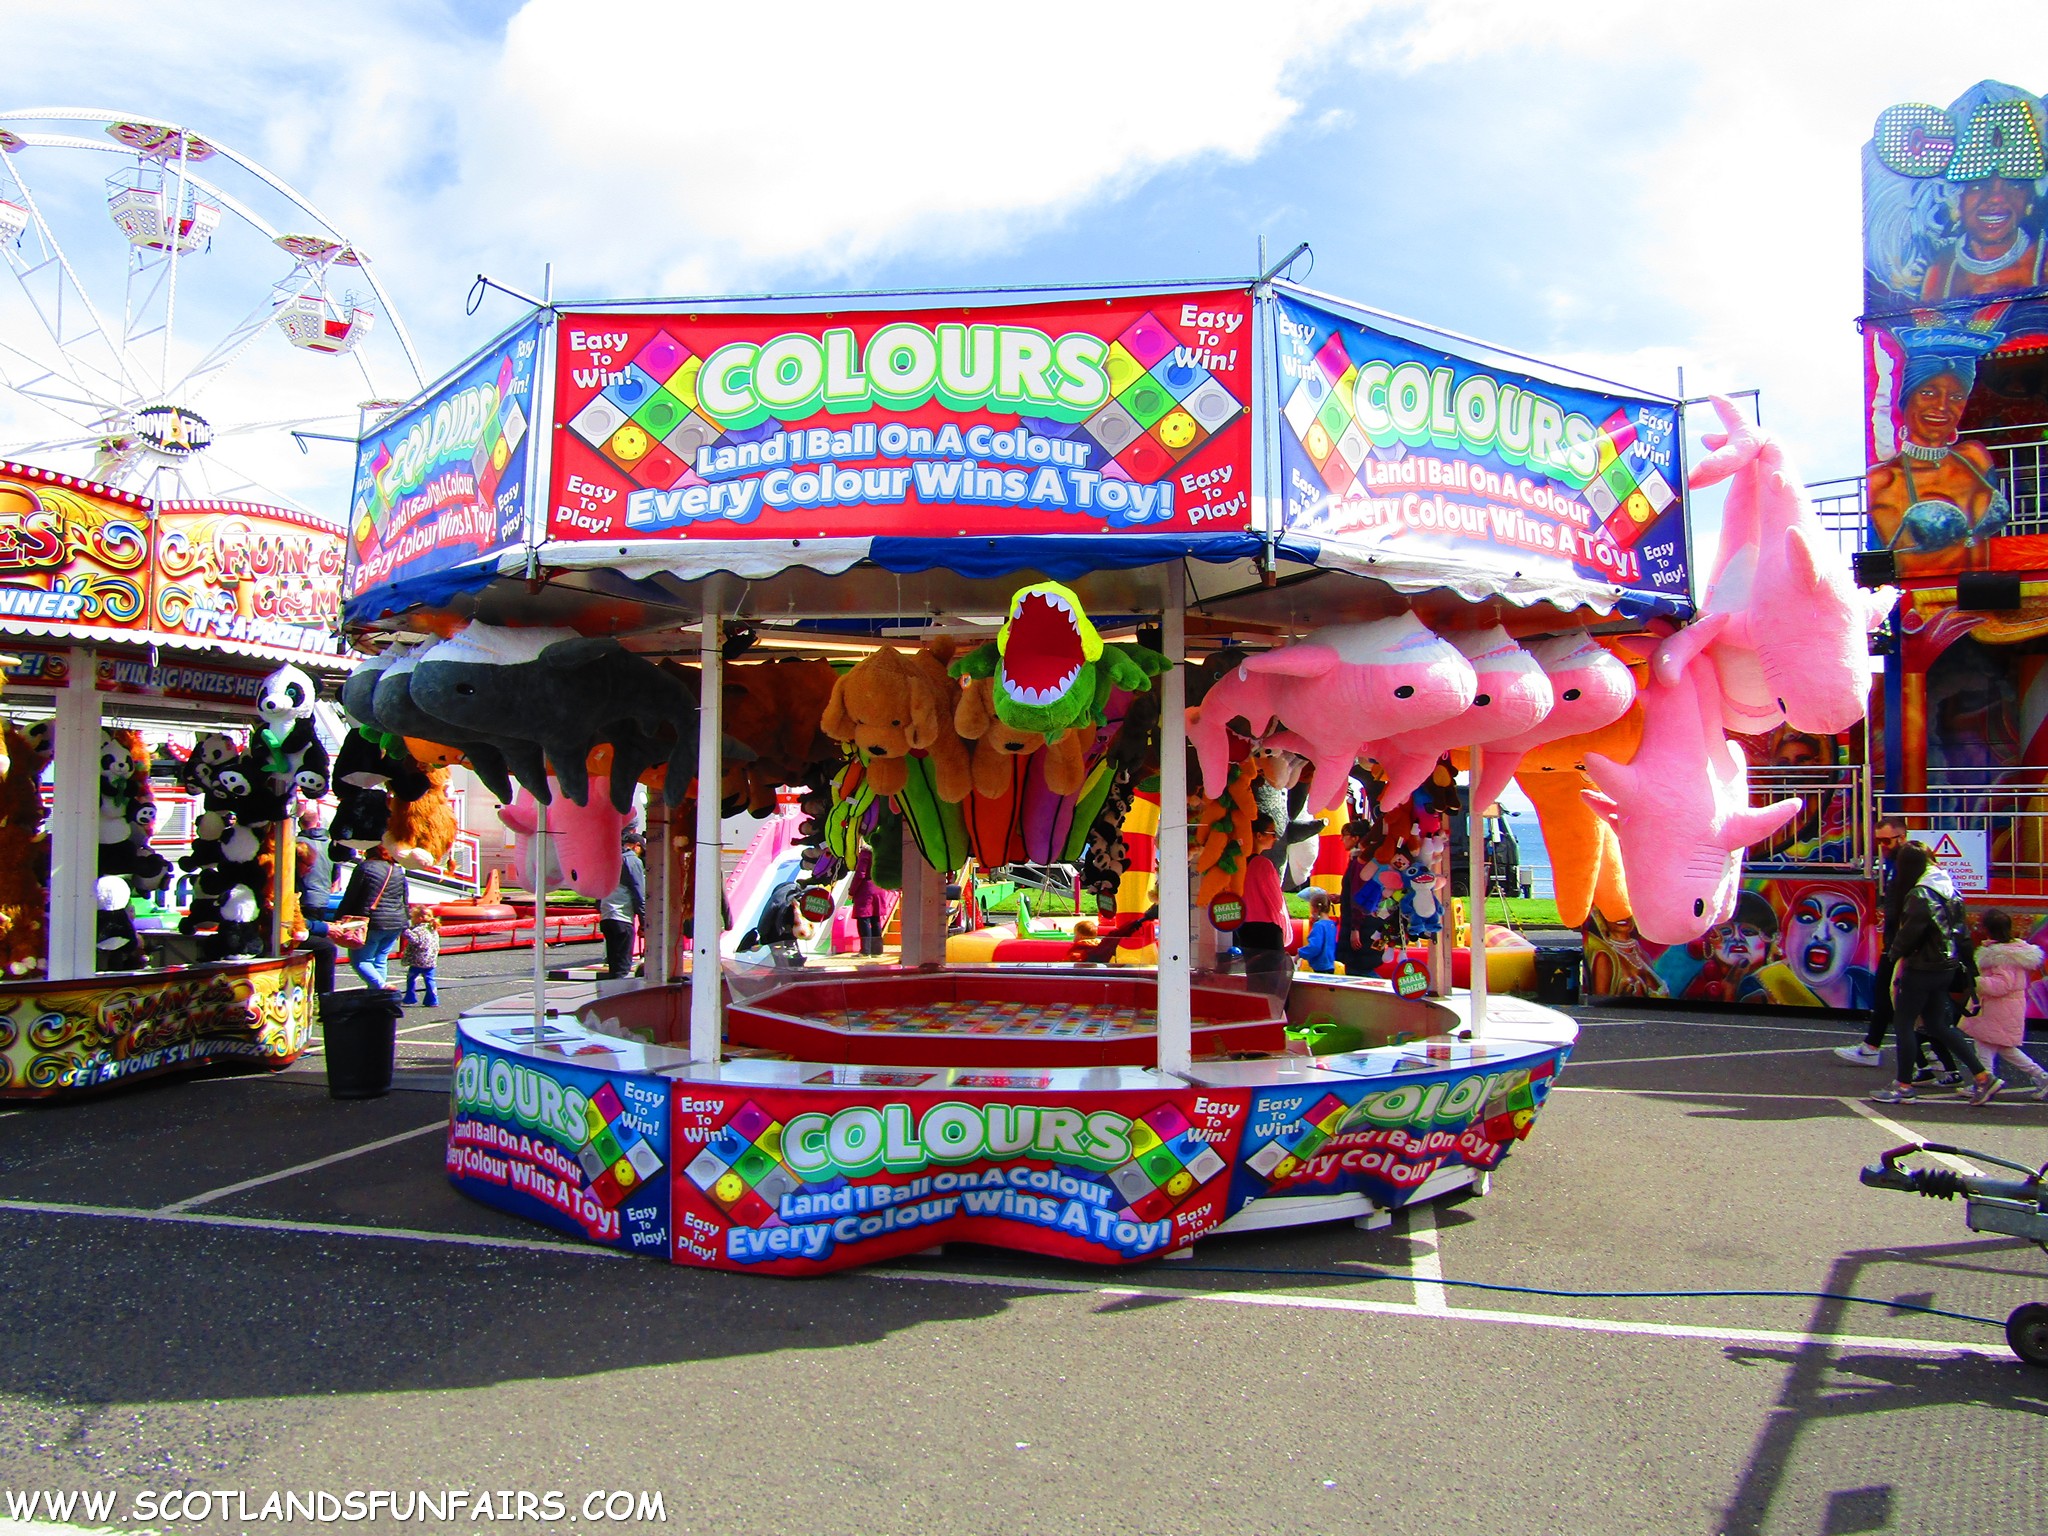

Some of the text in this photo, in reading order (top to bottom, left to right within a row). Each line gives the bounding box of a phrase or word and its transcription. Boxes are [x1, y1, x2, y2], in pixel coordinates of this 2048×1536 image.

[1180, 305, 1243, 333] Easy
[1280, 313, 1315, 344] Easy
[571, 331, 628, 354] Easy
[1197, 331, 1220, 347] To
[1291, 338, 1304, 356] To
[590, 352, 612, 366] To
[697, 323, 1110, 416] COLOURS
[1174, 346, 1237, 371] Win!
[1282, 354, 1317, 382] Win!
[573, 365, 632, 388] Win!
[1353, 361, 1600, 481] COLOURS
[1638, 407, 1674, 437] Easy
[384, 382, 497, 500] COLOURS
[1646, 429, 1661, 444] To
[698, 423, 1091, 478] Land 1 Ball On A Colour
[1633, 440, 1671, 468] Win!
[566, 475, 618, 503] Easy
[1181, 465, 1233, 494] Easy
[1292, 468, 1320, 503] Easy
[1366, 458, 1591, 526] Land 1 Ball On A Colour
[498, 482, 519, 512] Easy
[580, 498, 597, 512] To
[626, 459, 1175, 526] Every Colour Wins A Toy!
[1202, 485, 1222, 502] To
[385, 501, 406, 543] Land
[411, 485, 432, 518] Ball
[445, 470, 475, 498] Colour
[504, 504, 514, 515] To
[556, 504, 613, 533] Play!
[1187, 491, 1248, 526] Play!
[501, 506, 523, 542] Play!
[1402, 493, 1489, 534] Colour
[1490, 508, 1556, 549] Wins
[1557, 524, 1580, 556] A
[1578, 530, 1640, 579] Toy!
[219, 534, 312, 578] FUN
[355, 547, 397, 592] Every
[396, 523, 439, 562] Colour
[438, 509, 465, 542] Wins
[464, 506, 473, 533] A
[472, 506, 497, 542] Toy!
[1643, 540, 1674, 565] Easy
[1652, 564, 1686, 587] Play!
[1656, 557, 1670, 569] To
[187, 609, 234, 638] IT'S
[232, 615, 248, 640] A
[247, 620, 304, 649] PRIZE
[115, 662, 149, 684] WIN
[150, 668, 179, 689] BIG
[180, 669, 235, 694] PRIZES
[1213, 901, 1242, 913] SMALL
[1215, 911, 1241, 922] PRIZE
[1399, 972, 1426, 986] SMALL
[1404, 963, 1414, 975] 4
[1401, 981, 1428, 995] PRIZES
[102, 981, 199, 1038] FUN
[74, 1047, 180, 1088] EVERYONE'S
[192, 1039, 267, 1059] WINNER
[456, 1053, 590, 1147] COLOURS
[623, 1081, 665, 1108] Easy
[681, 1096, 724, 1116] Easy
[1257, 1097, 1303, 1113] Easy
[634, 1102, 648, 1116] To
[696, 1114, 712, 1127] To
[1194, 1097, 1240, 1119] Easy
[1271, 1111, 1287, 1121] To
[621, 1111, 660, 1137] Win!
[1206, 1115, 1222, 1127] To
[1254, 1119, 1300, 1138] Win!
[684, 1125, 729, 1143] Win!
[780, 1101, 1133, 1174] COLOURS
[1187, 1127, 1231, 1143] Win!
[1329, 1131, 1376, 1147] and
[1429, 1130, 1455, 1148] On
[455, 1120, 472, 1139] Land
[477, 1122, 498, 1145] Ball
[498, 1128, 519, 1151] On
[520, 1135, 533, 1156] A
[533, 1141, 583, 1184] Colour
[1341, 1149, 1430, 1182] Colour
[1461, 1131, 1500, 1164] oy!
[464, 1147, 509, 1180] Colour
[510, 1159, 556, 1199] Wins
[556, 1184, 574, 1210] A
[572, 1188, 621, 1236] Toy!
[780, 1165, 1112, 1219] Land 1 Ball On A Colour
[627, 1206, 658, 1222] Easy
[638, 1219, 651, 1231] To
[683, 1212, 720, 1236] Easy
[727, 1187, 1173, 1258] Every Colour Wins A Toy!
[1176, 1202, 1212, 1227] Easy
[1190, 1218, 1203, 1230] To
[632, 1229, 667, 1248] Play!
[678, 1235, 717, 1262] Play!
[693, 1230, 706, 1242] To
